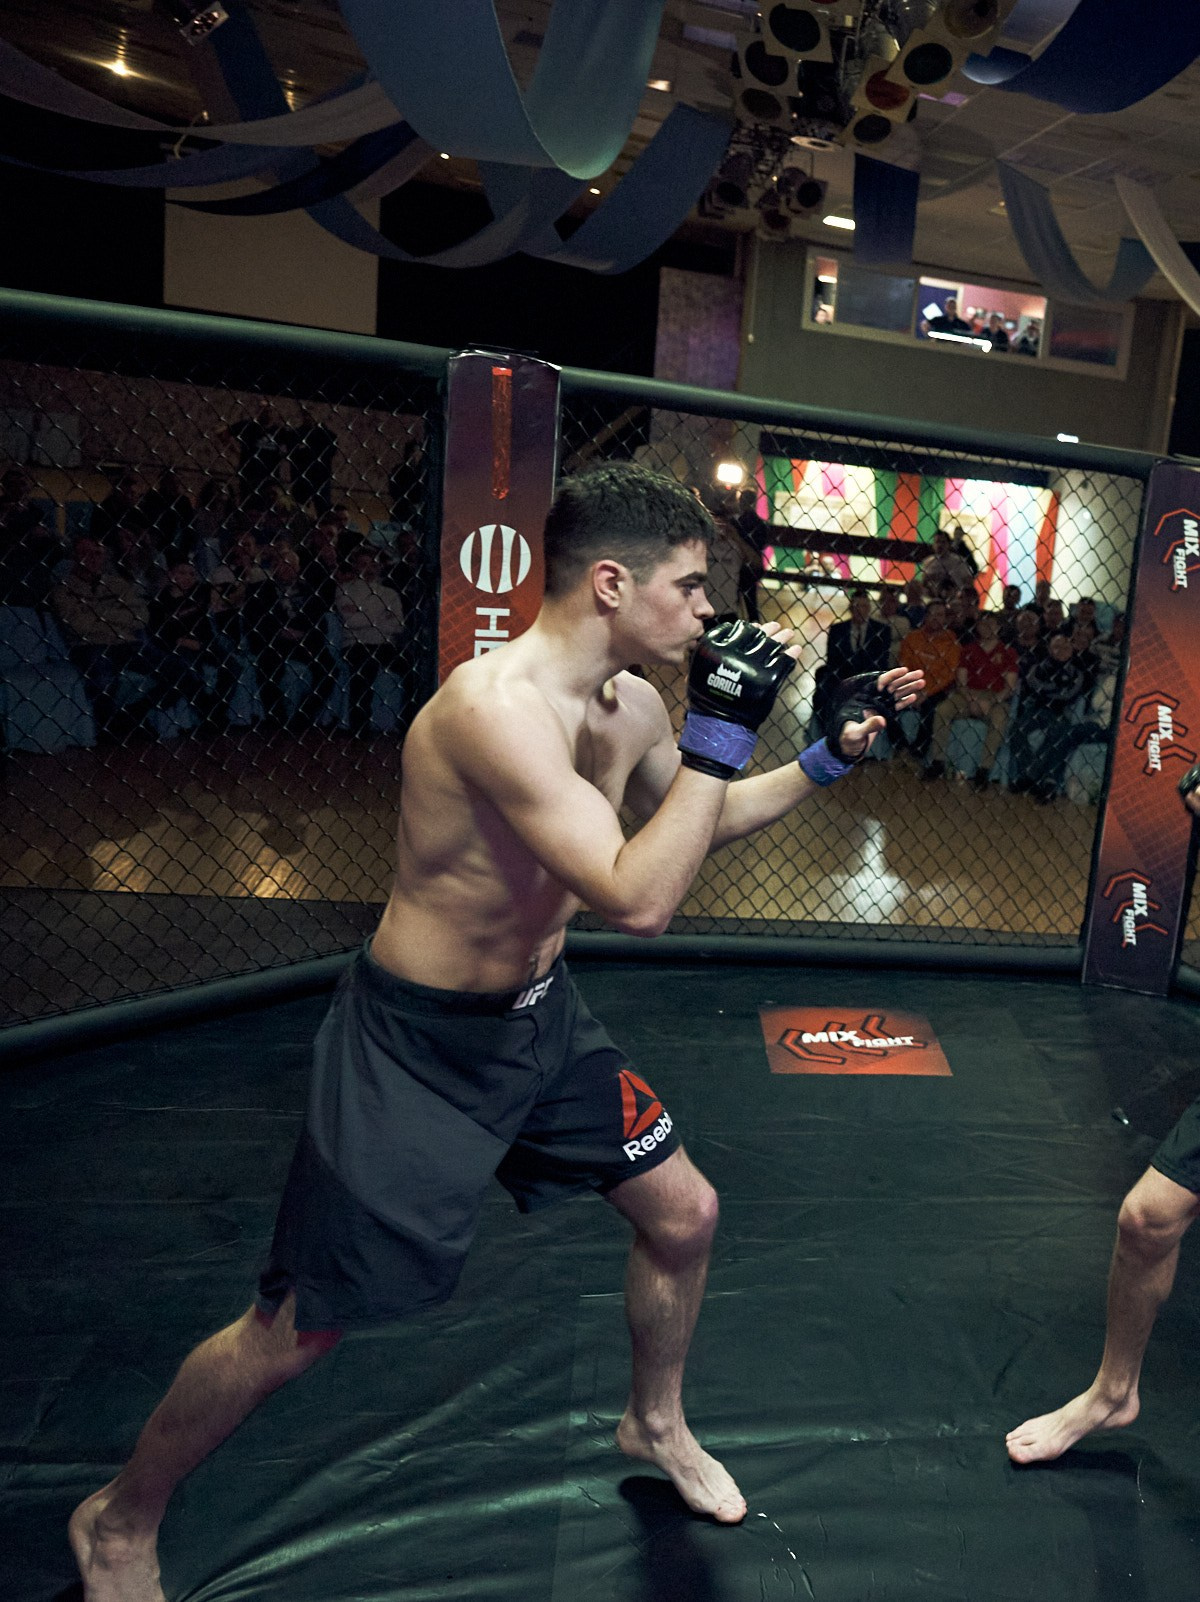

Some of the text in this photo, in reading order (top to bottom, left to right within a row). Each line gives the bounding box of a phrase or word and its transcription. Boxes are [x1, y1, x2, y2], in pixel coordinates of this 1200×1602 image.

[1183, 519, 1200, 557] MIX
[1174, 548, 1187, 588] FIGHT
[707, 673, 743, 698] GORILLA
[1157, 705, 1174, 742] MIX
[1148, 732, 1162, 772] FIGHT
[1132, 882, 1149, 918] MIX
[1123, 908, 1137, 946] FIGHT
[801, 1030, 858, 1044] MIX
[852, 1036, 914, 1048] FIGHT
